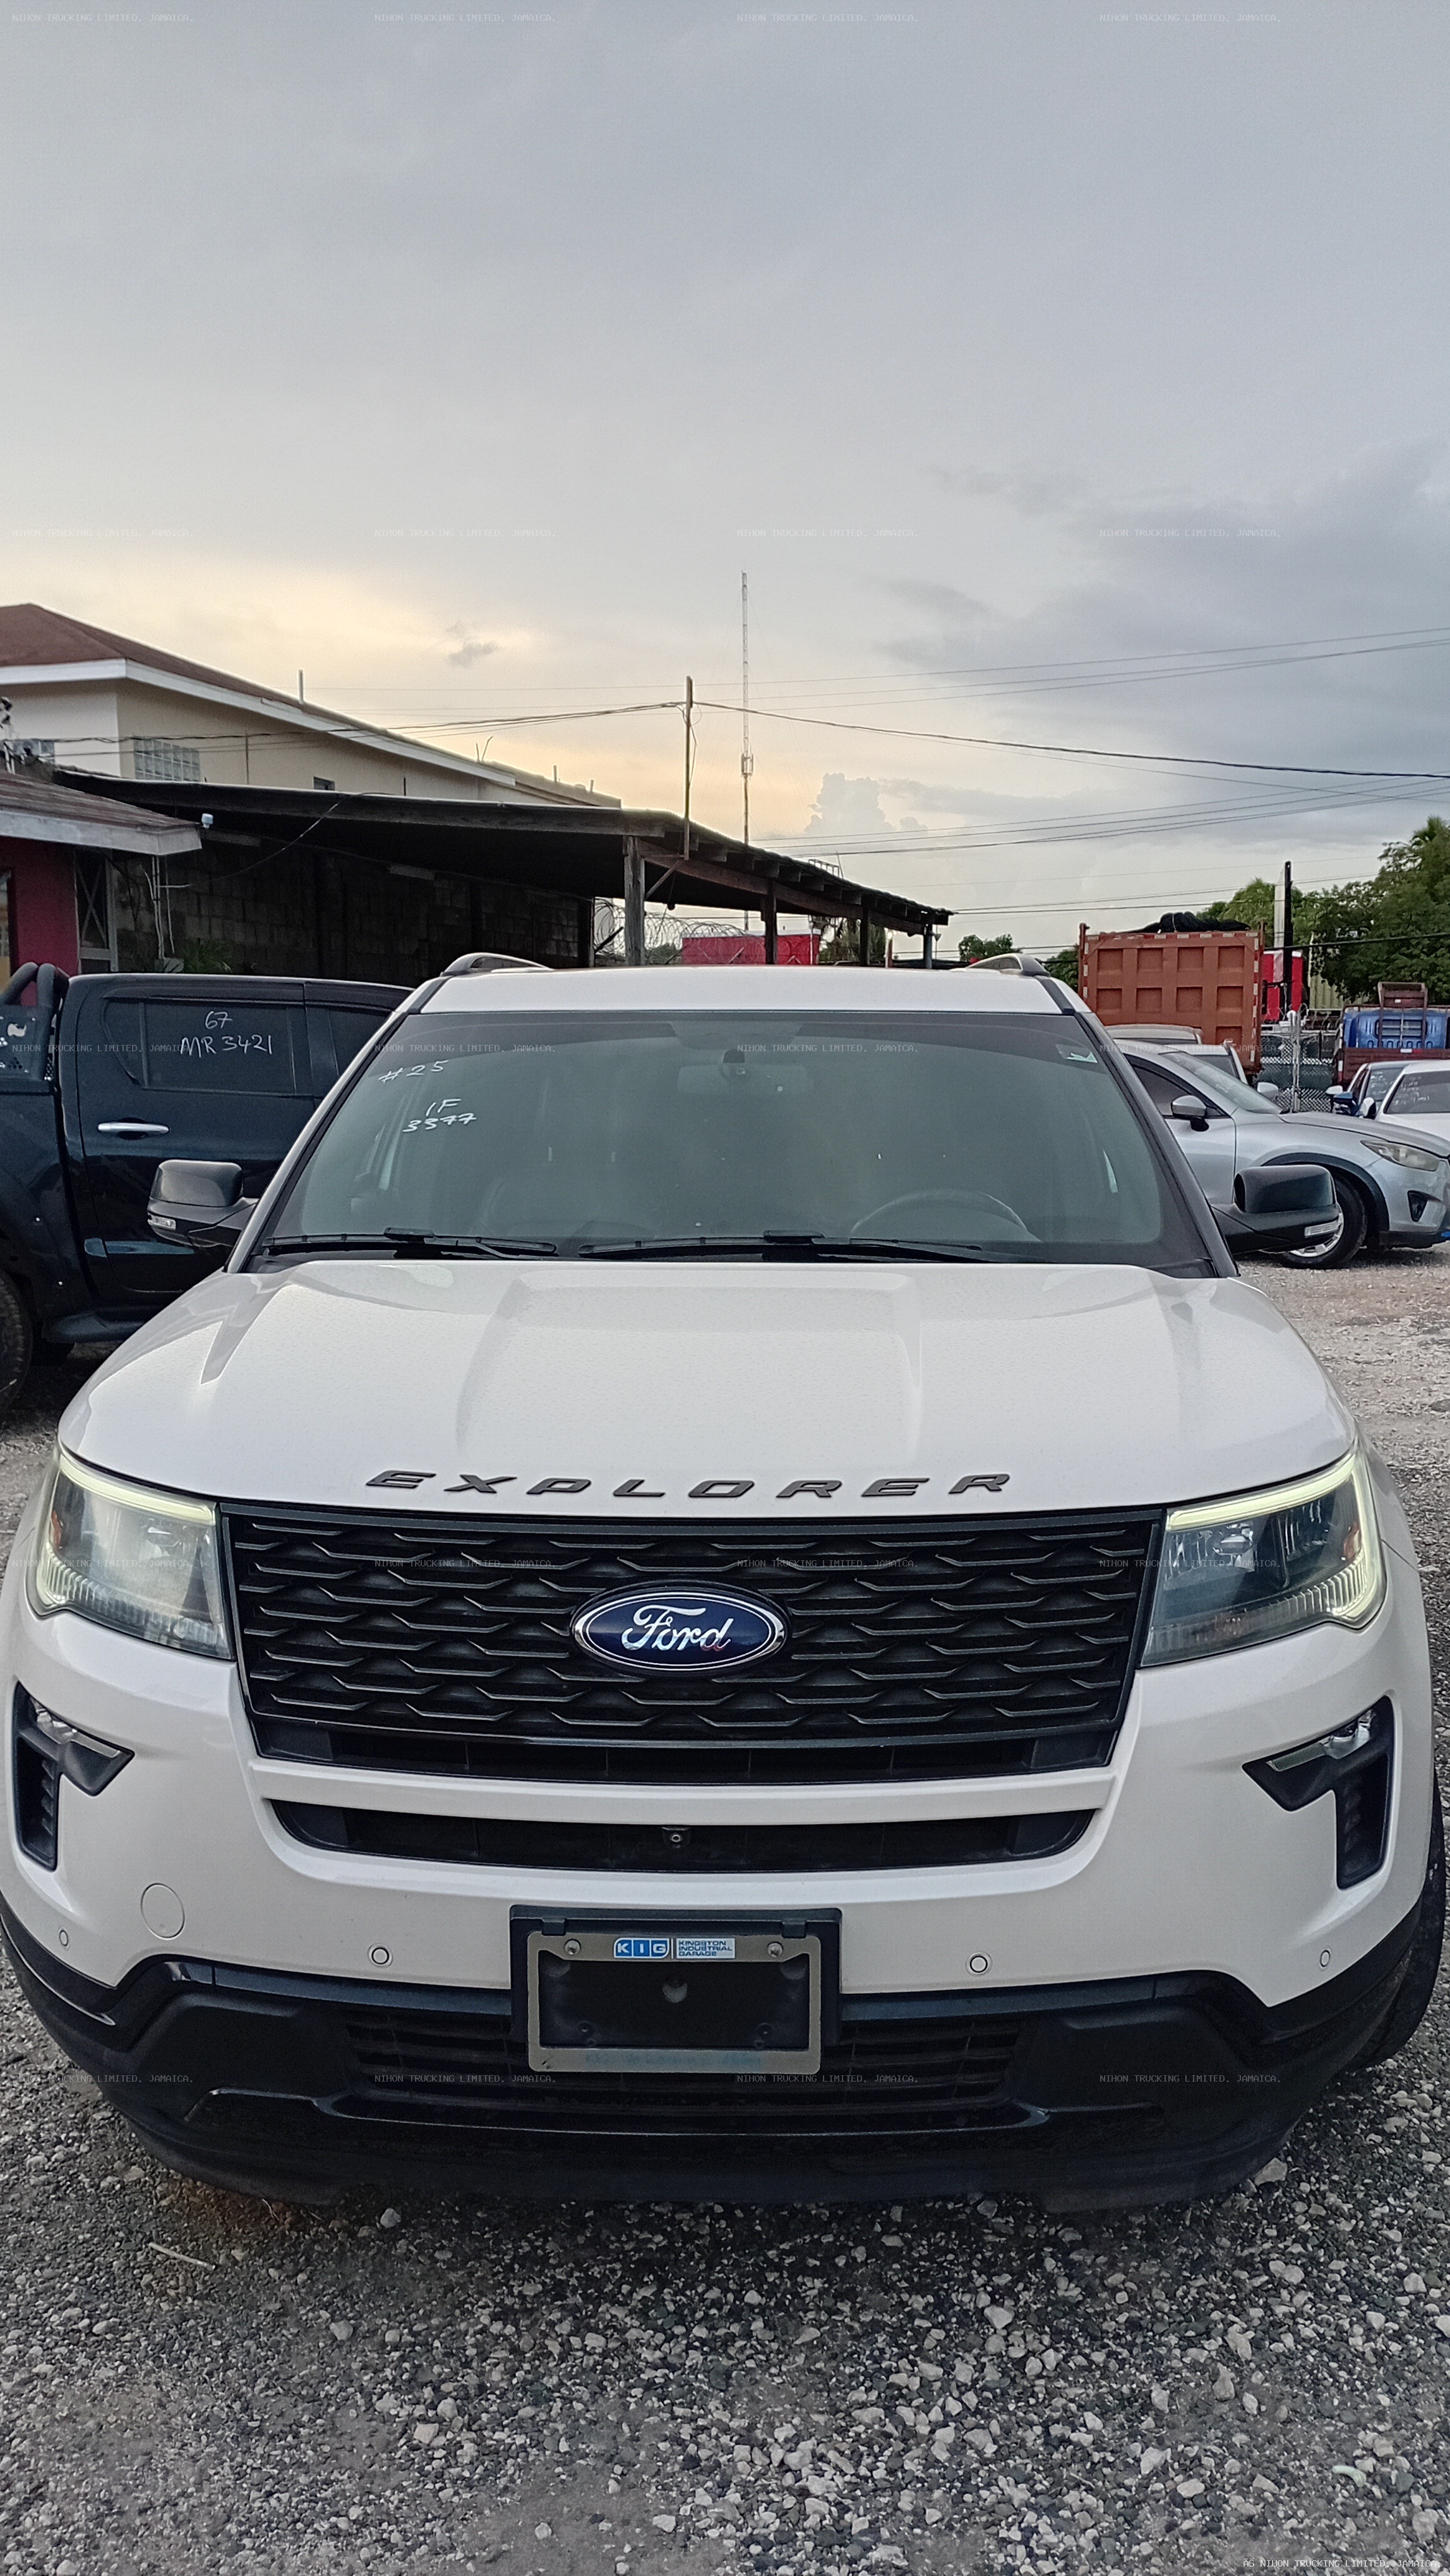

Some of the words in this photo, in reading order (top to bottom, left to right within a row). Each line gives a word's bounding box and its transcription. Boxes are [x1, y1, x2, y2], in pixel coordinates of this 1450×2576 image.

[205, 1011, 232, 1029] 67
[180, 1036, 217, 1058] MR
[222, 1034, 272, 1054] 3421
[402, 1112, 477, 1133] 3377
[366, 1469, 1010, 1498] EXPLORER
[621, 1604, 734, 1651] Ford
[617, 1943, 666, 1953] KIG
